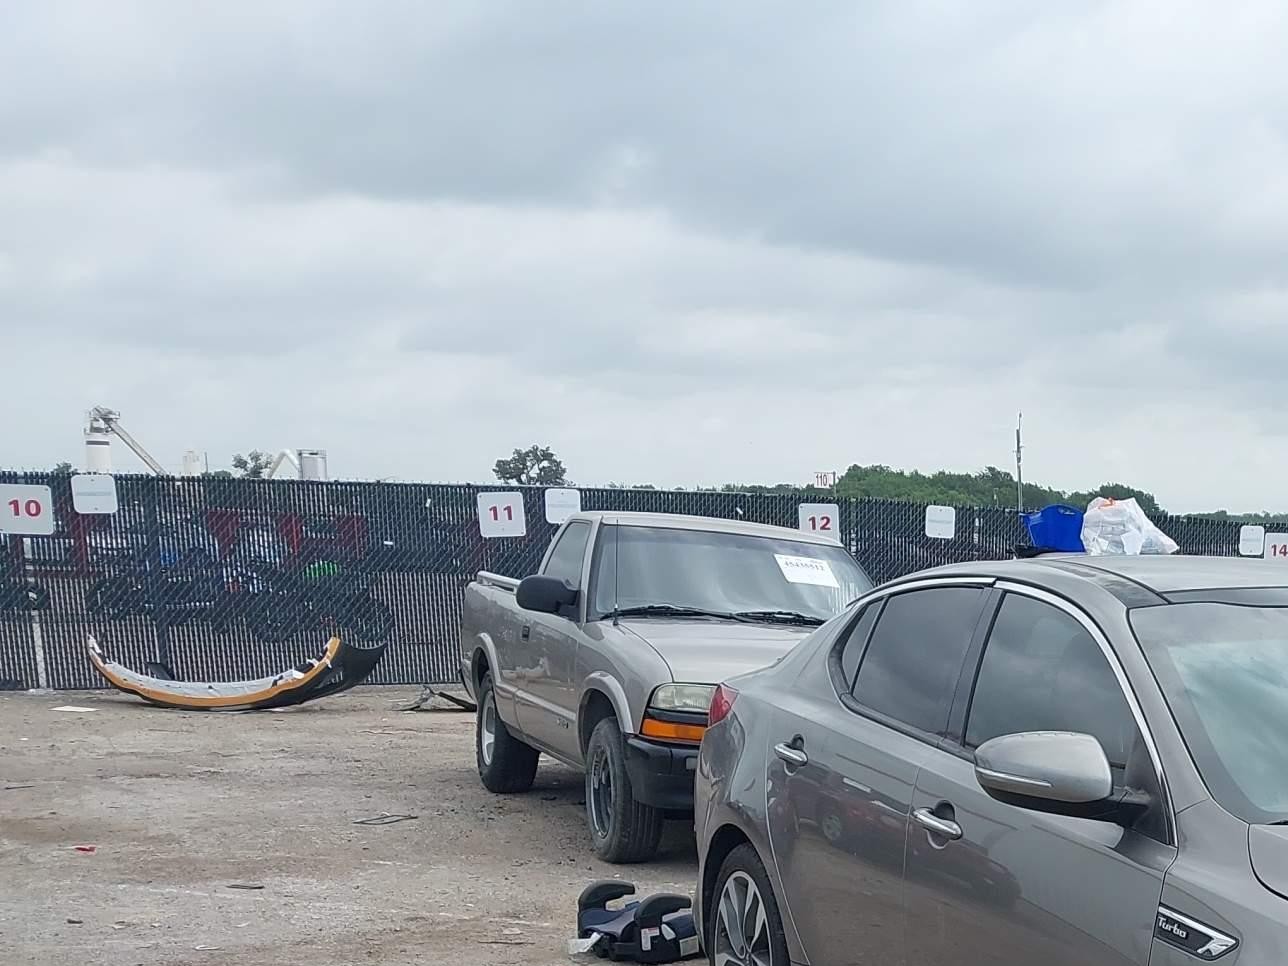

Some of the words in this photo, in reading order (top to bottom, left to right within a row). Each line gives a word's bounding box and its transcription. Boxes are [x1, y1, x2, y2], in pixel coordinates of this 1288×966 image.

[8, 499, 41, 517] 10
[489, 505, 513, 521] 11
[808, 516, 831, 531] 12
[1271, 544, 1288, 557] 14
[1158, 916, 1187, 938] Turbo
